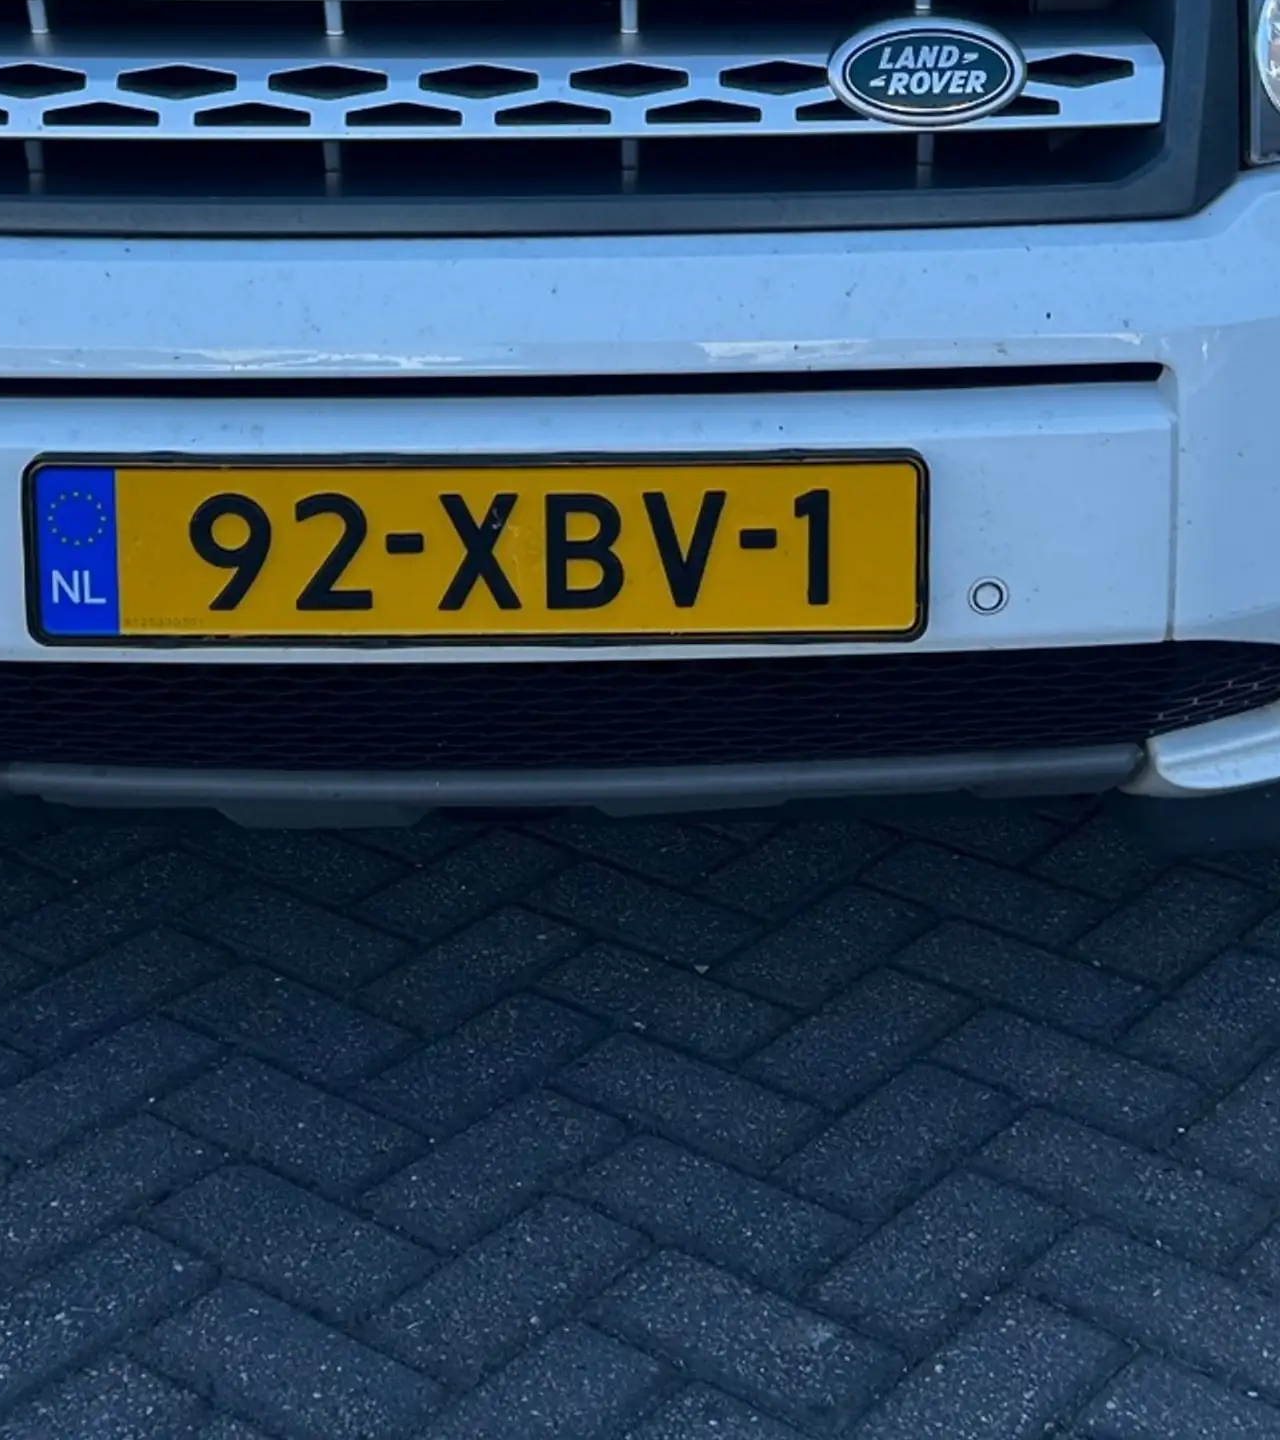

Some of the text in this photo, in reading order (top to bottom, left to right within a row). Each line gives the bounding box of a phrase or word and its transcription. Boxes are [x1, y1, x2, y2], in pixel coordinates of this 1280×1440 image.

[878, 45, 959, 70] LAND
[887, 70, 987, 96] ROVER
[188, 488, 832, 613] 92-XBV-1
[51, 569, 108, 605] NL
